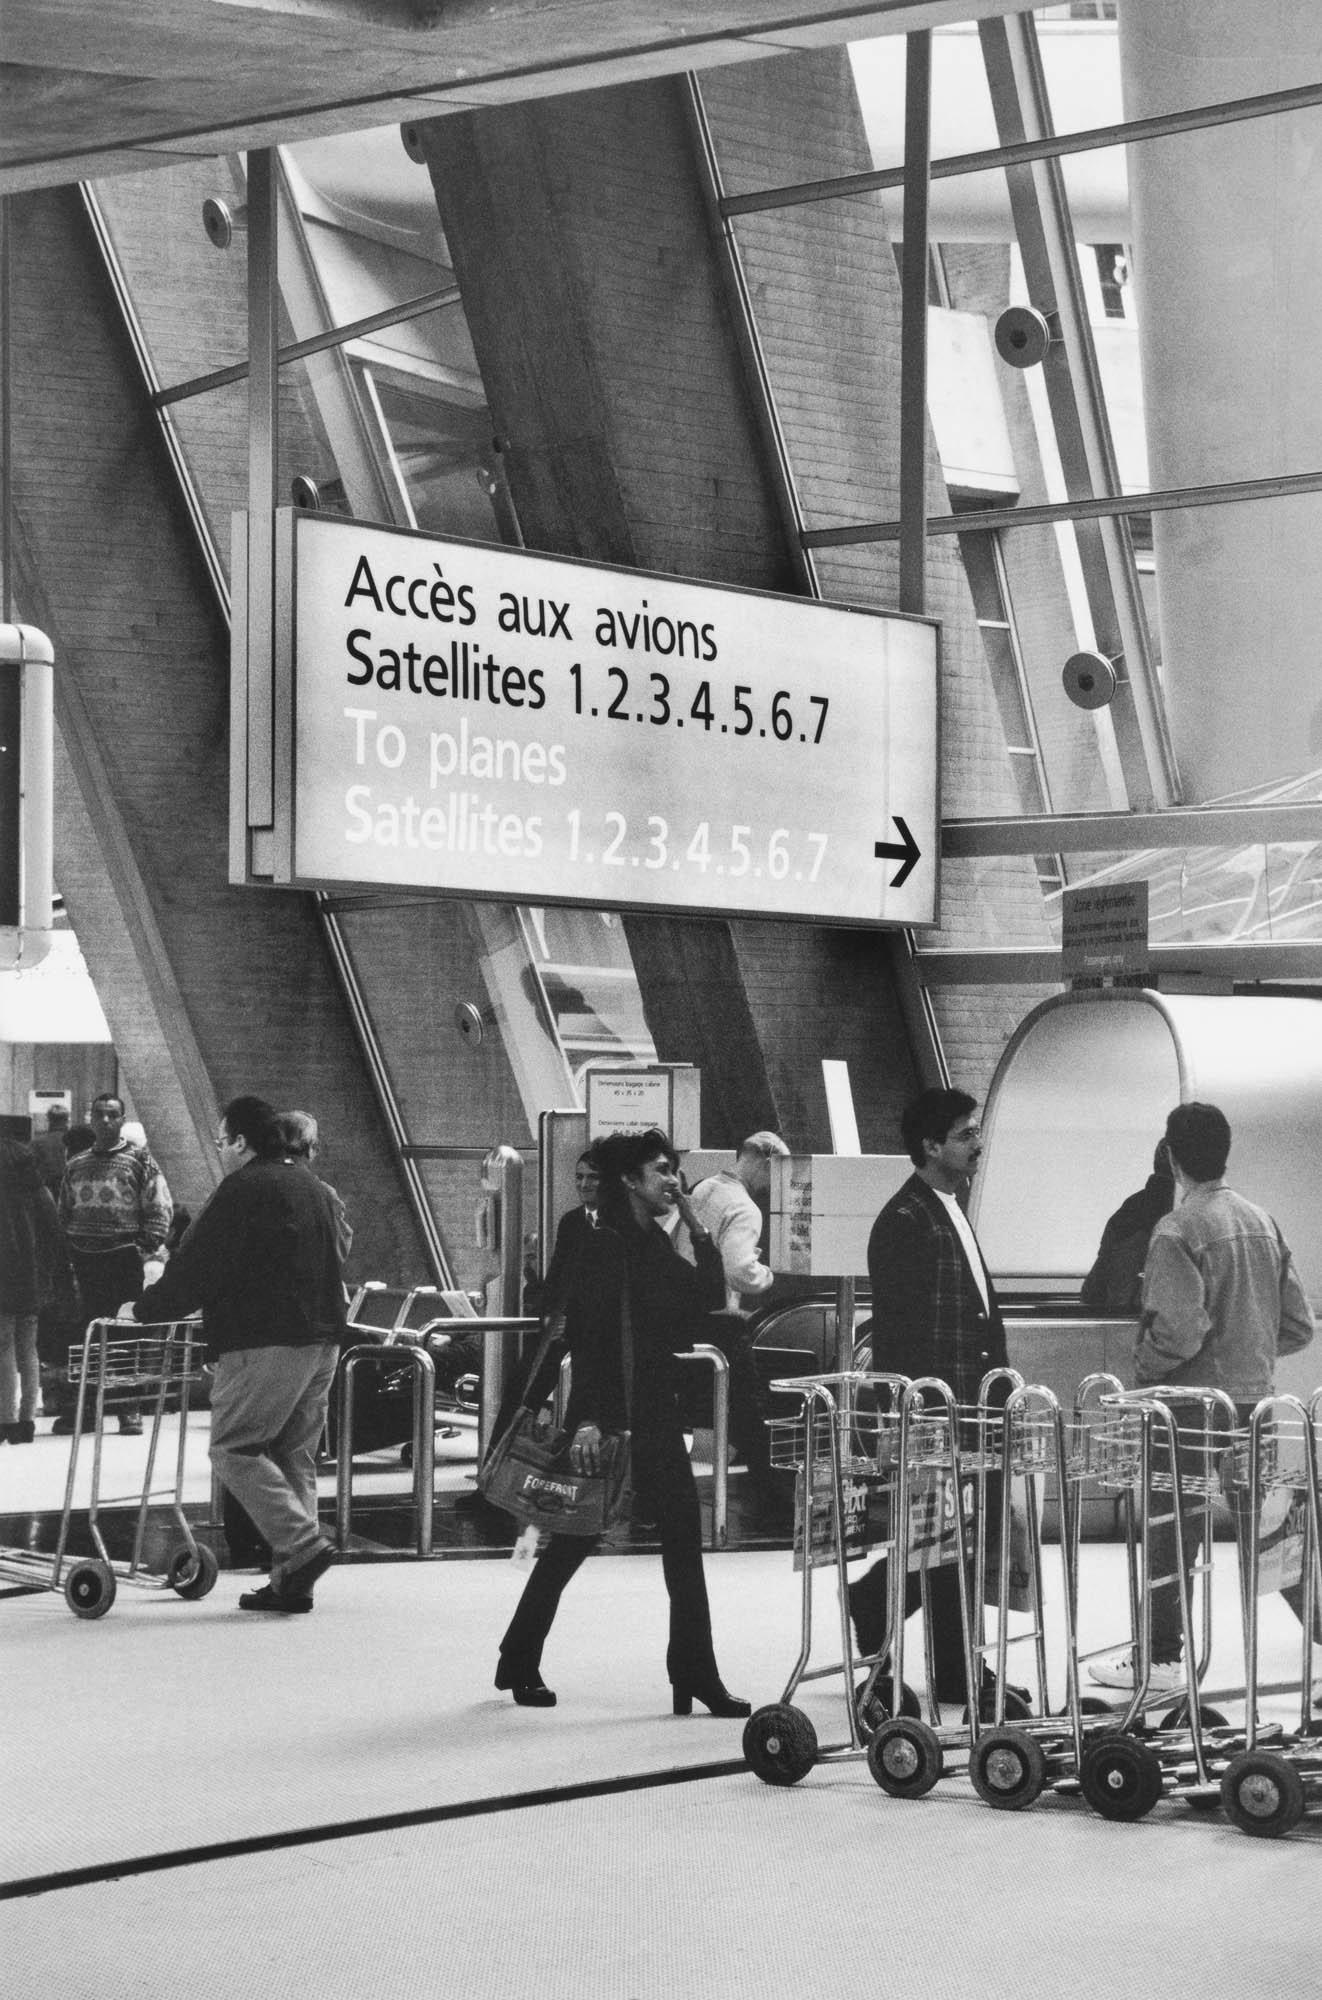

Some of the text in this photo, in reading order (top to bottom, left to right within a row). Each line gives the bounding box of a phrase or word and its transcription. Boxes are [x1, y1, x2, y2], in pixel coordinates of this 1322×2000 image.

[344, 555, 718, 661] Accès aux avions
[346, 628, 829, 744] Satellites 1.2.3.4.5.6.7
[343, 707, 567, 789] To planes
[344, 784, 829, 884] Satellites 1.2.3.4.5.6.7
